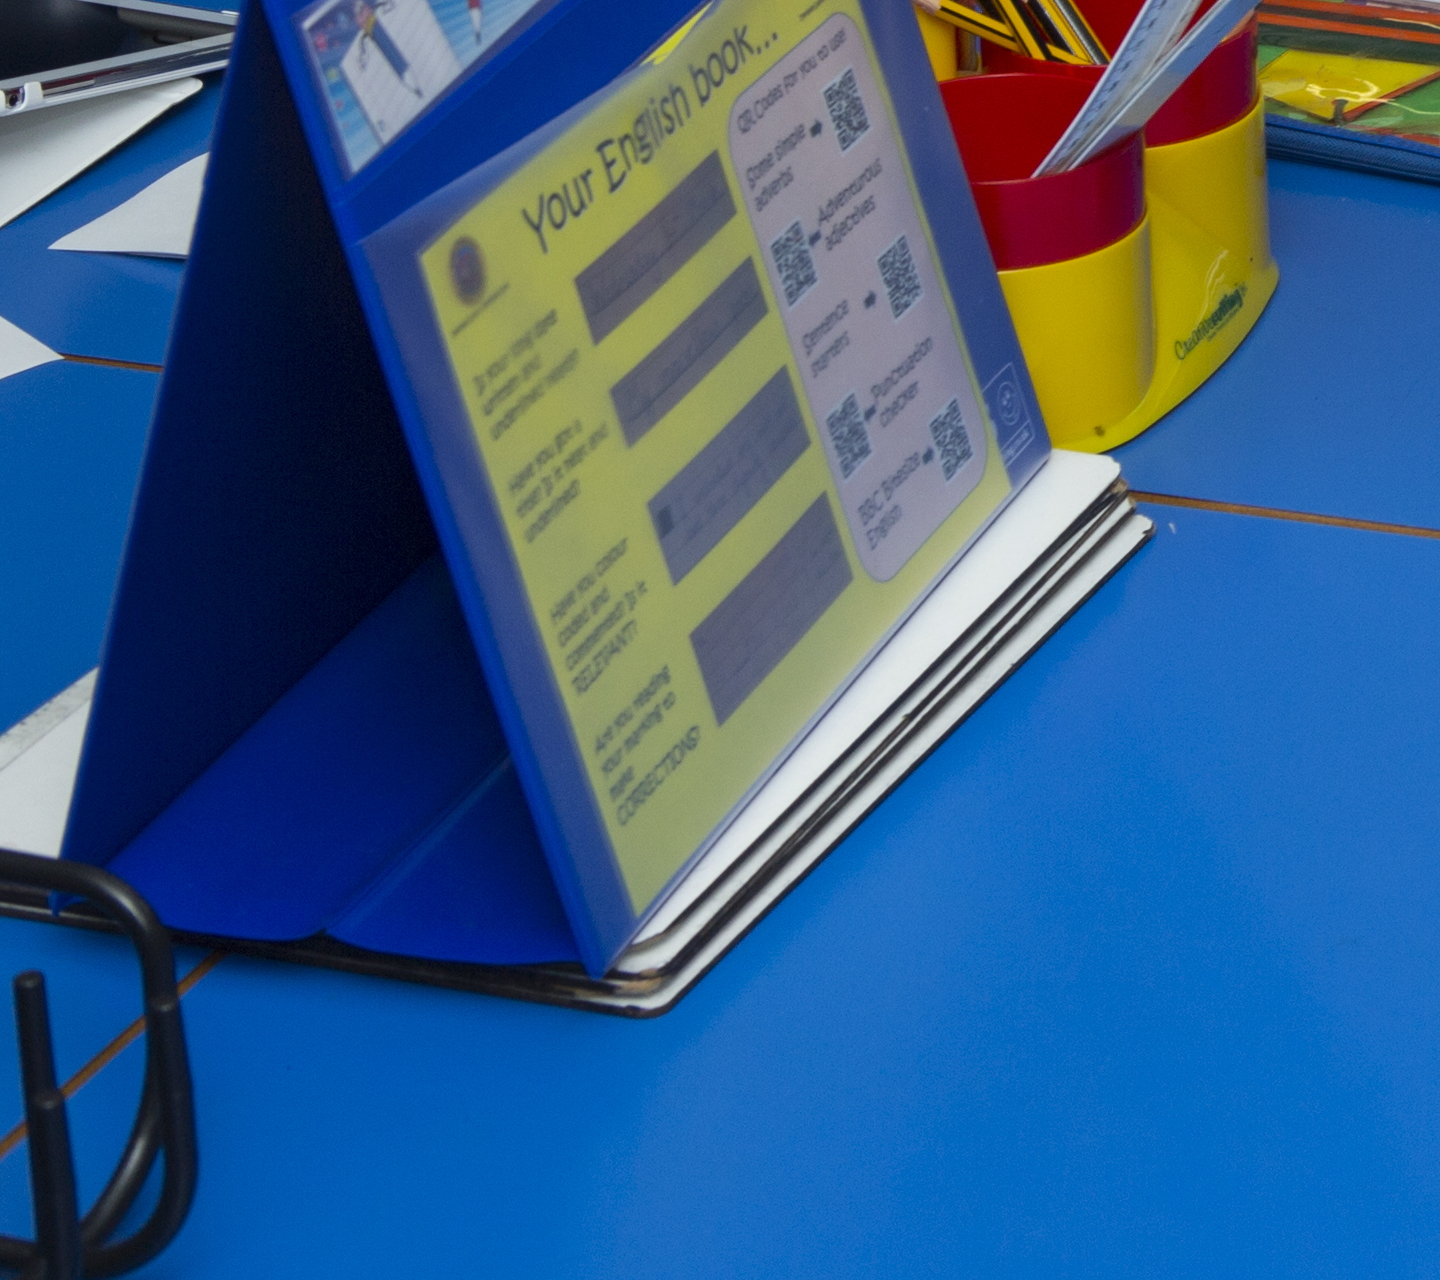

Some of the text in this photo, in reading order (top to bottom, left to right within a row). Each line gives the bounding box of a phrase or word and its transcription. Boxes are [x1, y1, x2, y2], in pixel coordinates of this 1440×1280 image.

[522, 171, 596, 254] Your
[596, 84, 693, 199] English
[817, 157, 883, 224] Adventurous
